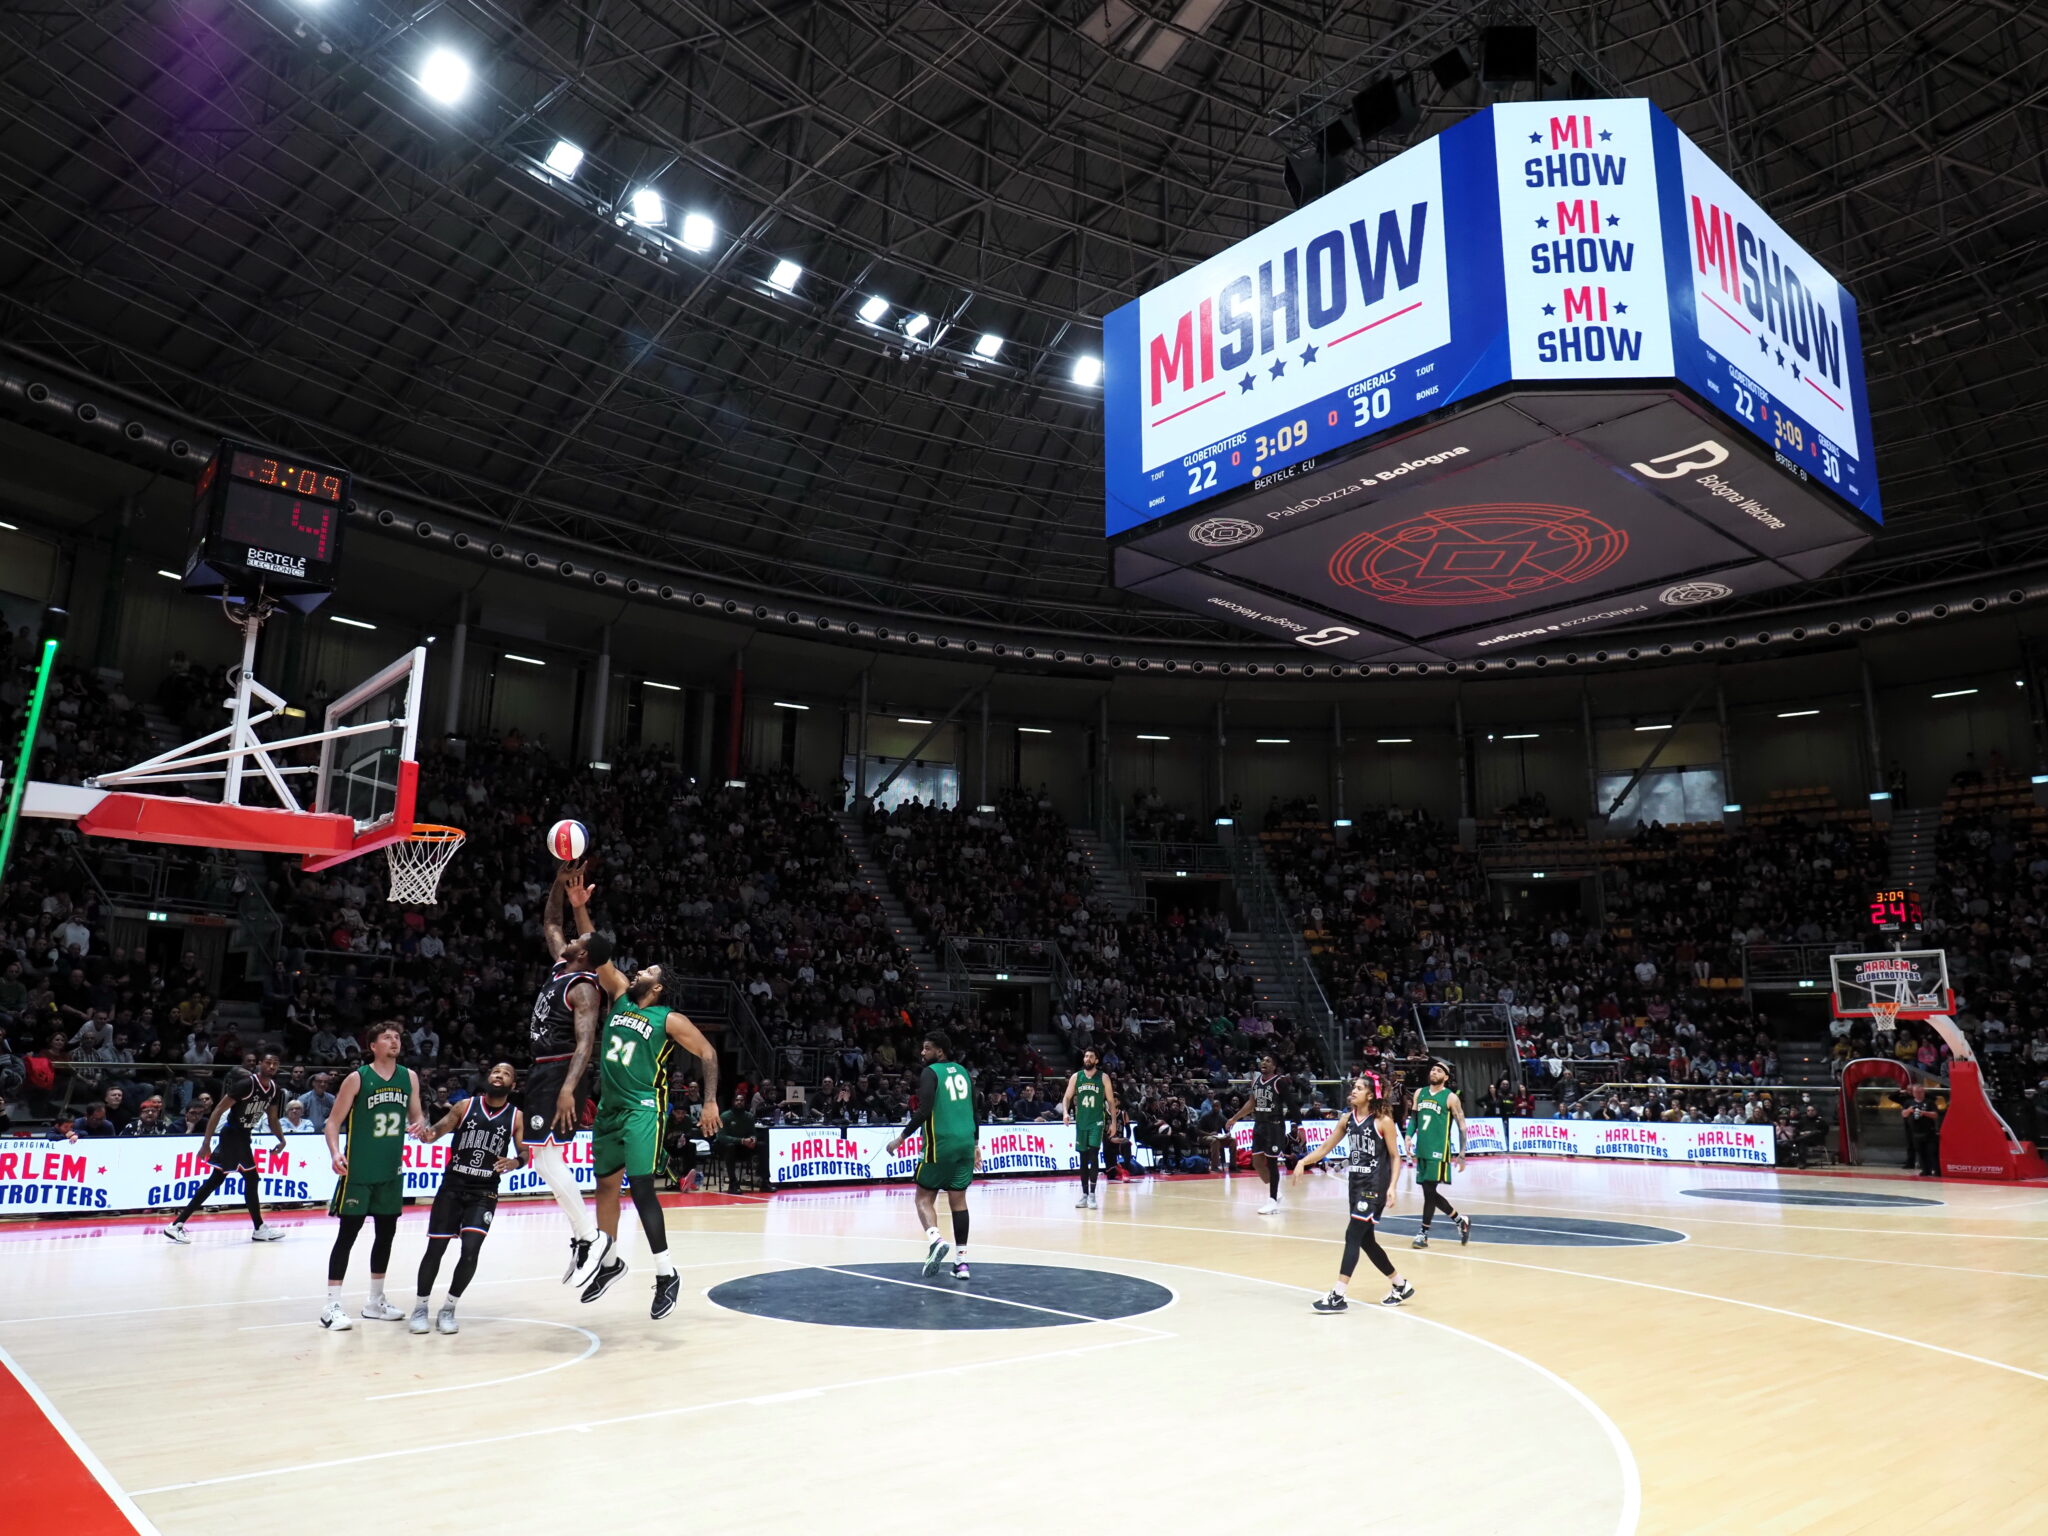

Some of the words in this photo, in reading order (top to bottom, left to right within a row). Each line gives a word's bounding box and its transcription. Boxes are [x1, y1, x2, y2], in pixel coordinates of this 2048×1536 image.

[1550, 115, 1592, 150] MI
[1524, 152, 1626, 188] SHOW
[1556, 199, 1600, 235] MI
[1531, 238, 1634, 273] SHOW
[1563, 286, 1607, 323] MI
[1537, 326, 1642, 362] SHOW
[1416, 363, 1434, 377] T.OUT
[1347, 369, 1396, 399] GENERALS
[1416, 385, 1439, 401] BONUS
[1729, 364, 1769, 403] GLOBETROTTERS
[1354, 388, 1391, 428] 30
[1733, 383, 1755, 423] 22
[1328, 410, 1338, 427] 0
[1255, 419, 1308, 462] 3:09
[1774, 410, 1803, 451] 3:09
[1183, 432, 1247, 467] GLOBETROTTERS
[1231, 451, 1240, 466] 0
[1151, 470, 1165, 482] T.OUT
[1188, 460, 1217, 494] 22
[1822, 449, 1840, 483] 30
[259, 459, 340, 500] 3:09
[1266, 484, 1362, 520] PalaDozza
[1362, 478, 1378, 487] è
[1375, 446, 1470, 482] Bologna
[1149, 495, 1165, 508] BONUS
[1696, 474, 1744, 503] Bologna
[1737, 499, 1786, 529] Welcome
[291, 502, 329, 558] 4
[1208, 597, 1261, 619] Welcome
[1561, 605, 1648, 627] PalaDozza
[1261, 615, 1308, 632] Bologna
[1477, 628, 1549, 646] Bologna
[1876, 891, 1904, 902] 3:09
[1870, 902, 1906, 924] 24
[1857, 971, 1920, 982] GLOBETROTTERS
[1864, 960, 1910, 972] HARLEM
[610, 1014, 653, 1040] GENERALS
[606, 1035, 637, 1066] 21
[945, 1074, 968, 1101] 19
[1078, 1085, 1099, 1093] GENERALS
[368, 1092, 409, 1109] GENERALS
[1082, 1096, 1095, 1108] 41
[374, 1113, 401, 1137] 32
[1422, 1115, 1431, 1130] 7
[1466, 1124, 1495, 1139] HARLEM
[1522, 1125, 1568, 1140] HARLEM
[13, 1142, 55, 1150] ORIGINAL
[991, 1134, 1046, 1155] HARLEM
[1513, 1139, 1578, 1153] GLOBETROTTERS
[1605, 1129, 1657, 1144] HARLEM
[1698, 1131, 1755, 1148] HARLEM
[470, 1150, 485, 1168] 3
[791, 1138, 858, 1162] HARLEM
[1596, 1143, 1668, 1158] GLOBETROTTERS
[1688, 1147, 1767, 1162] GLOBETROTTERS
[0, 1152, 87, 1183] RLEM
[778, 1160, 871, 1183] GLOBETROTTERS
[983, 1154, 1057, 1174] GLOBETROTTERS
[0, 1184, 108, 1208] TROTTERS
